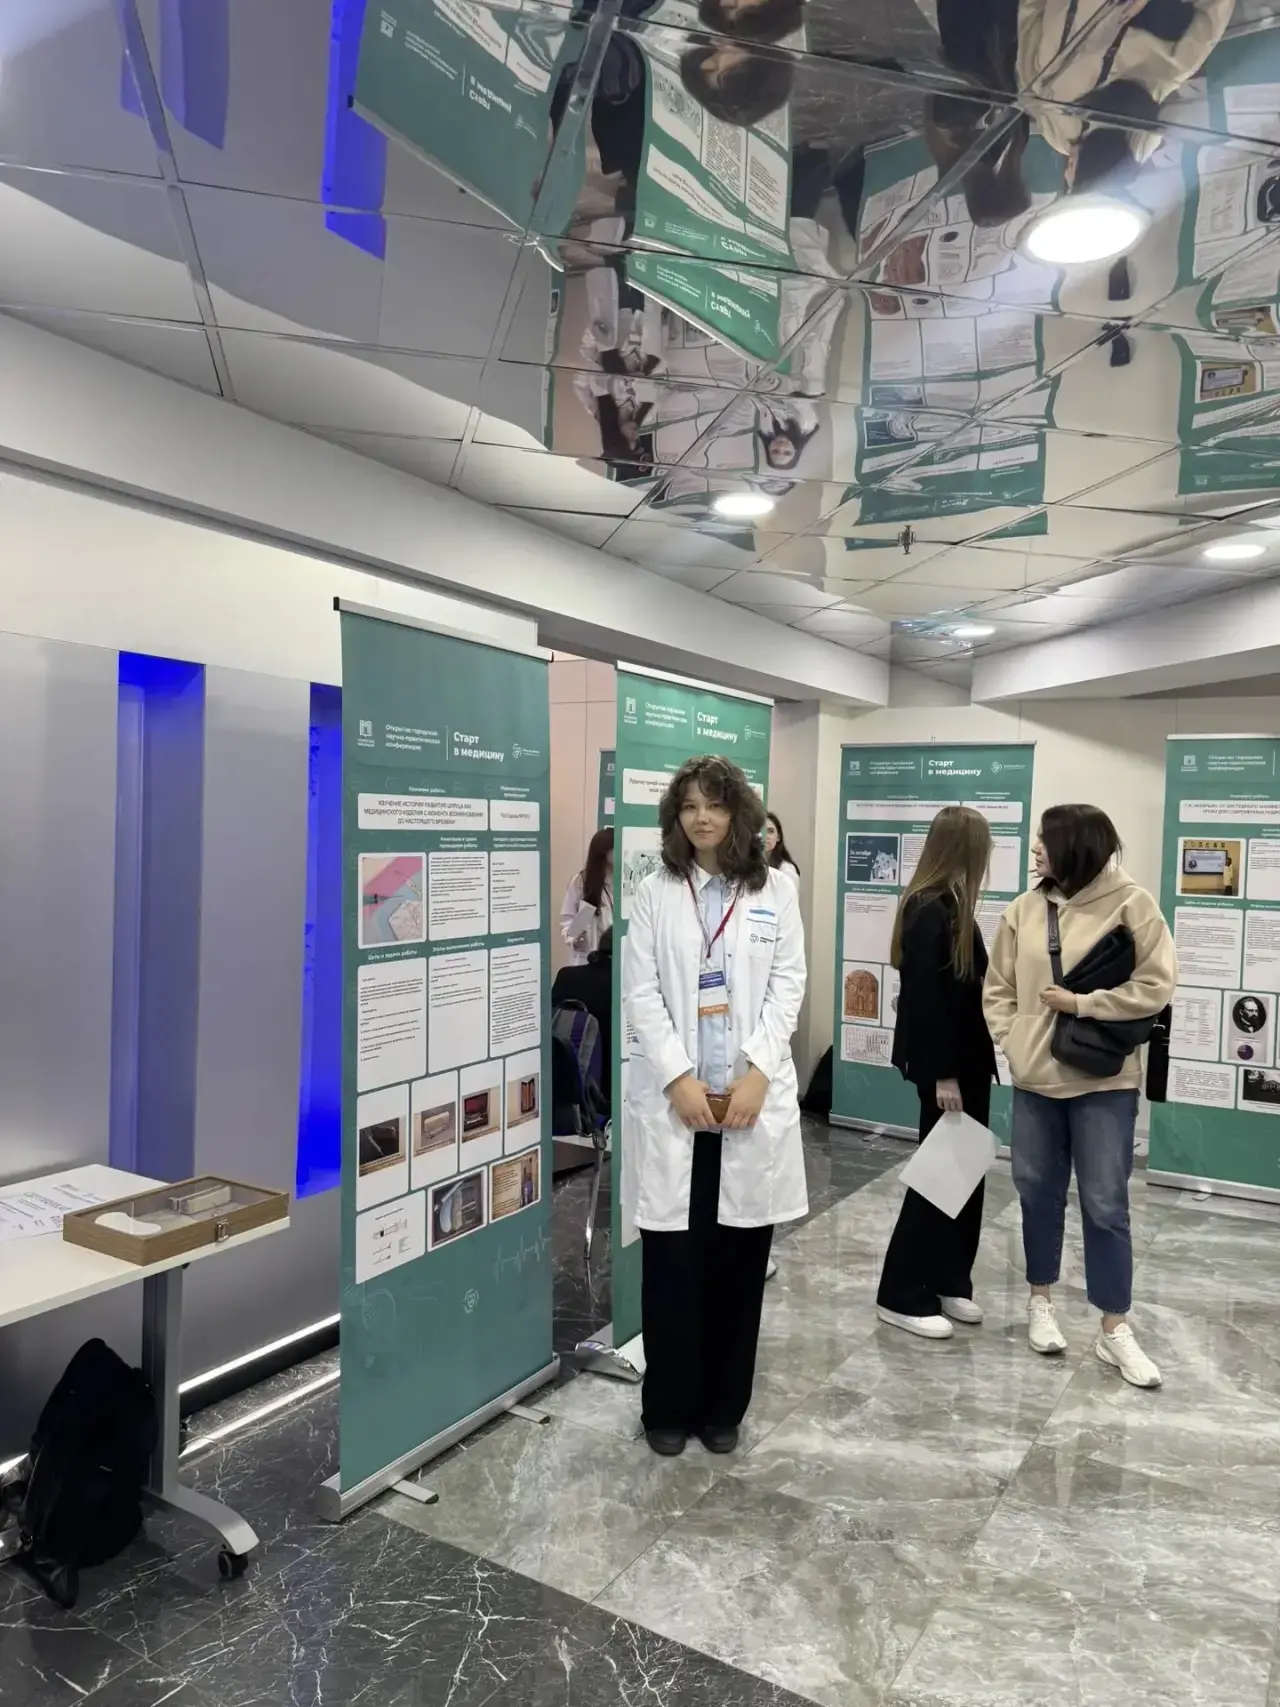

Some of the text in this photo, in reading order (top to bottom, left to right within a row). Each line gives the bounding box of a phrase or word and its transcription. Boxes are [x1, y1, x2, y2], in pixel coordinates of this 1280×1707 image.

[697, 712, 719, 725] Старт
[453, 731, 479, 745] Старт
[702, 728, 738, 744] медицину
[454, 748, 505, 762] в медицину
[928, 759, 954, 768] Старт
[935, 769, 982, 777] медицину
